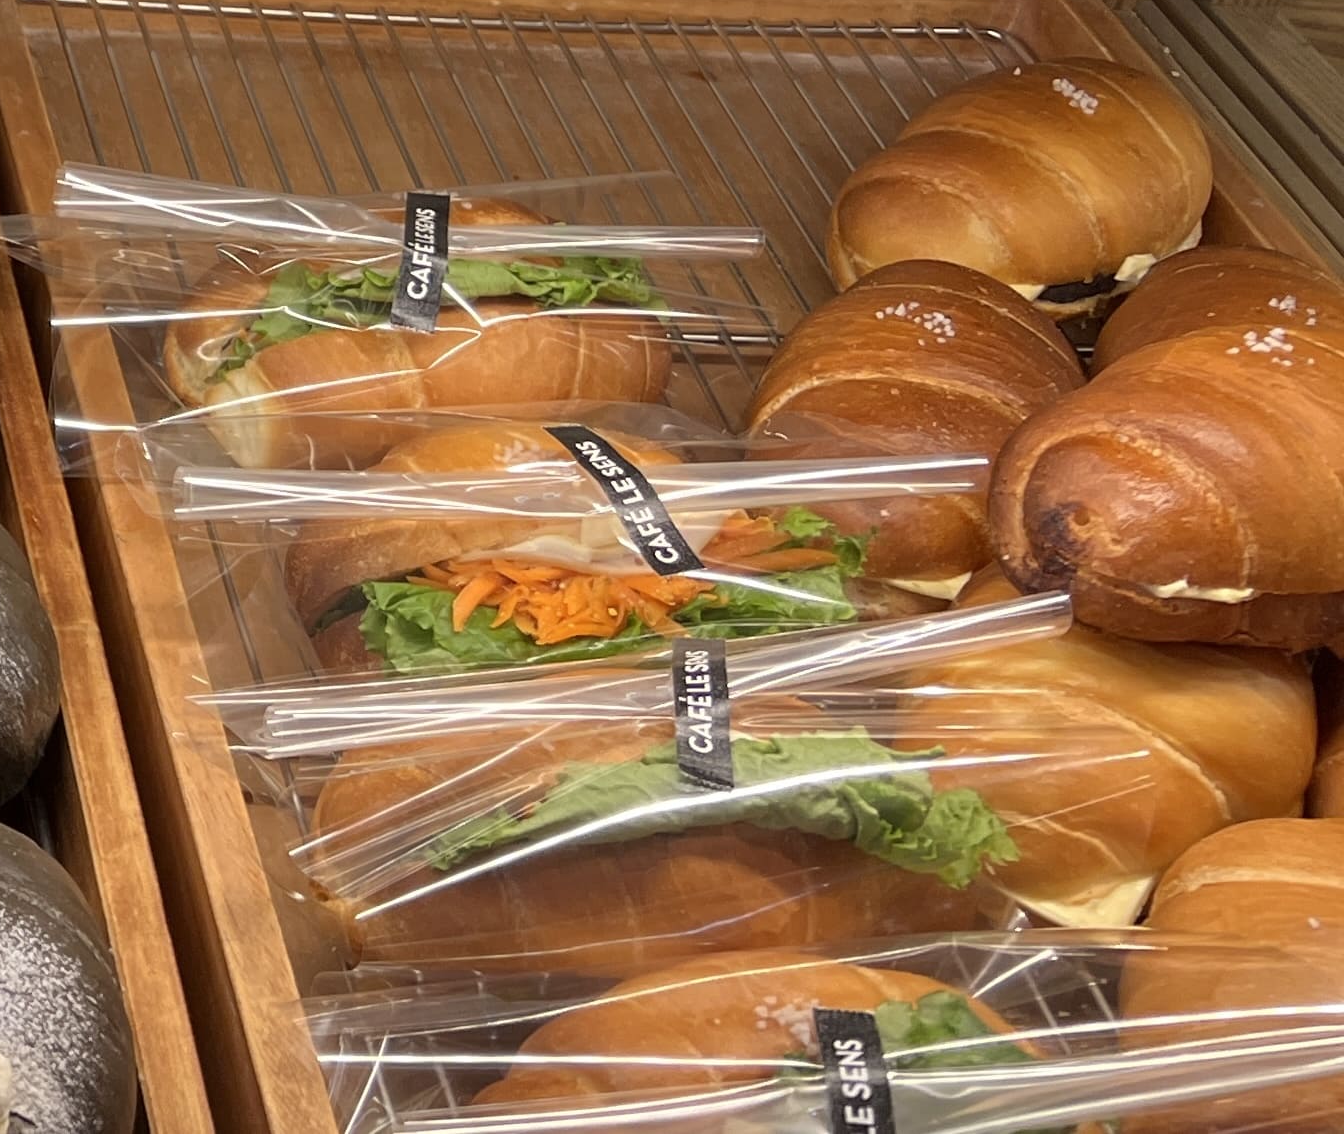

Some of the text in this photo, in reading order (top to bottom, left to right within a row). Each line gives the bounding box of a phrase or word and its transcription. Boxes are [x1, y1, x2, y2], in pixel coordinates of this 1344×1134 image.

[406, 242, 435, 300] CAFÉ
[575, 440, 679, 564] CAFÉ LE SENS
[685, 674, 711, 698] LE
[678, 695, 714, 754] CAFÉ
[833, 1039, 871, 1101] SENS
